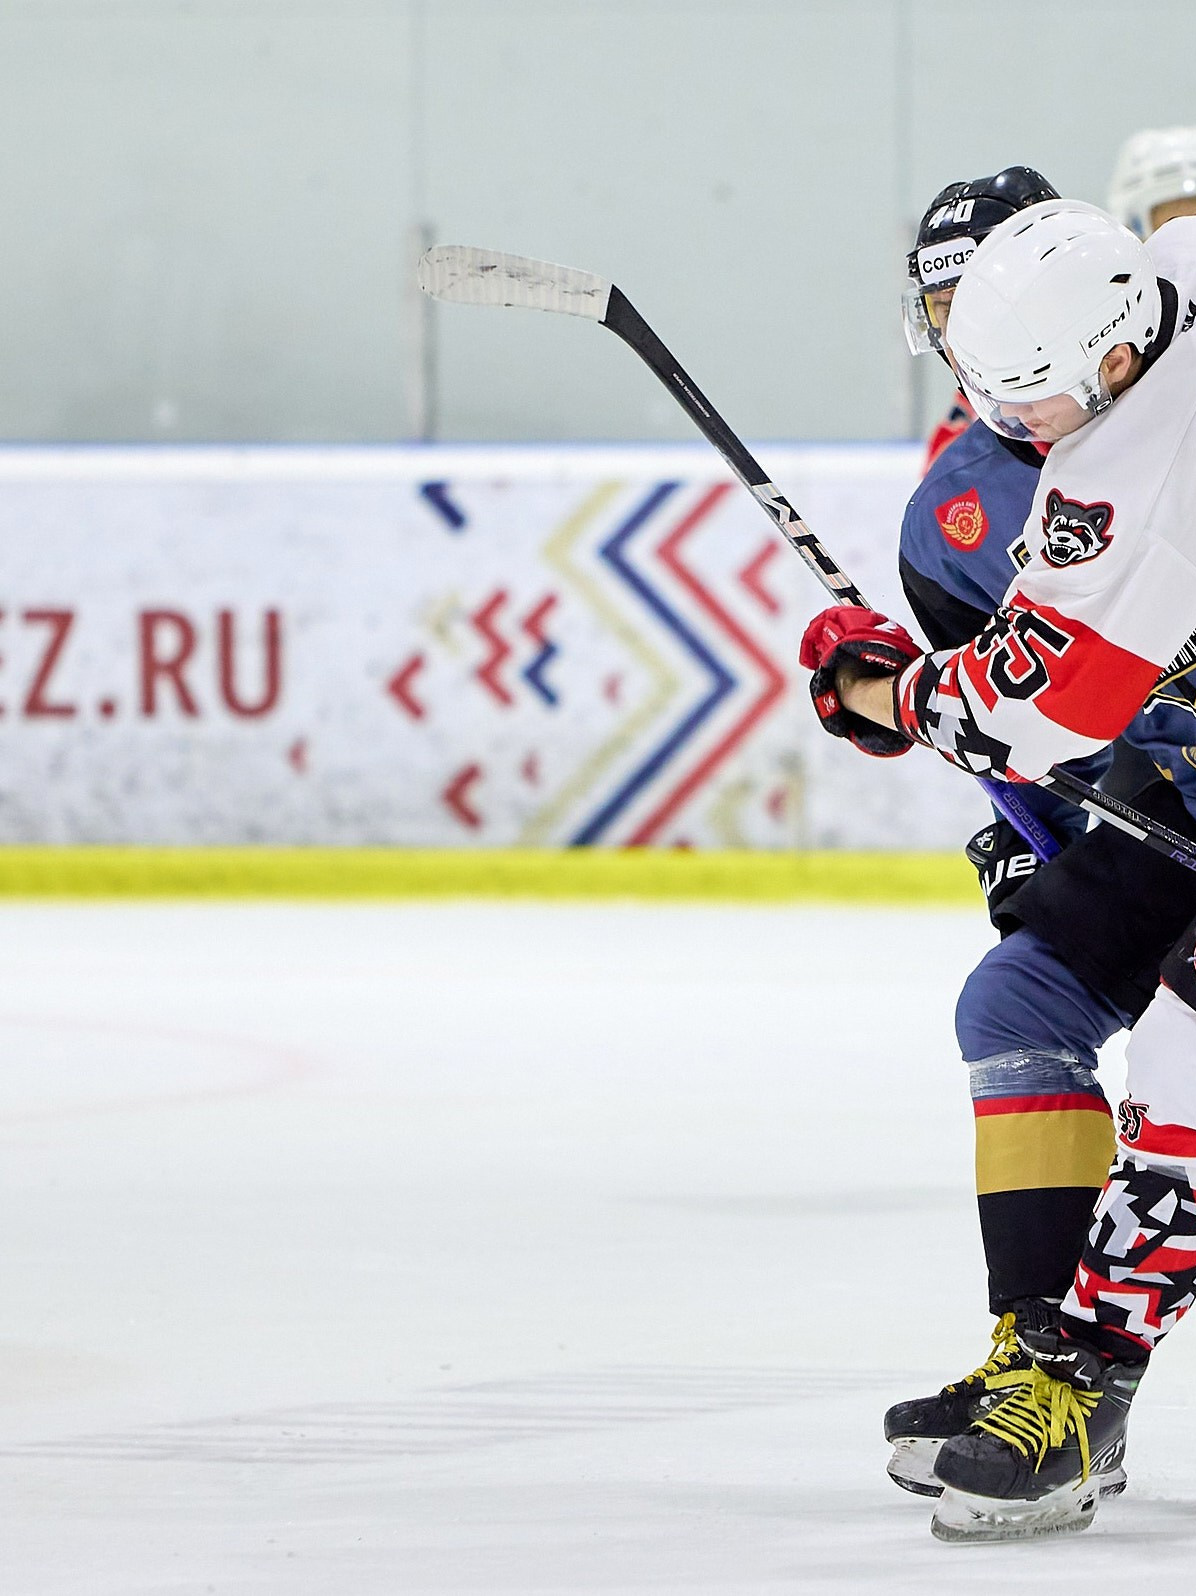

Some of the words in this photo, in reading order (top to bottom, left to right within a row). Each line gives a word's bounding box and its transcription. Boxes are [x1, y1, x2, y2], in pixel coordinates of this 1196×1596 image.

[1088, 311, 1126, 349] CCM
[0, 607, 282, 720] Z.RU
[1003, 793, 1049, 849] TRIGGER
